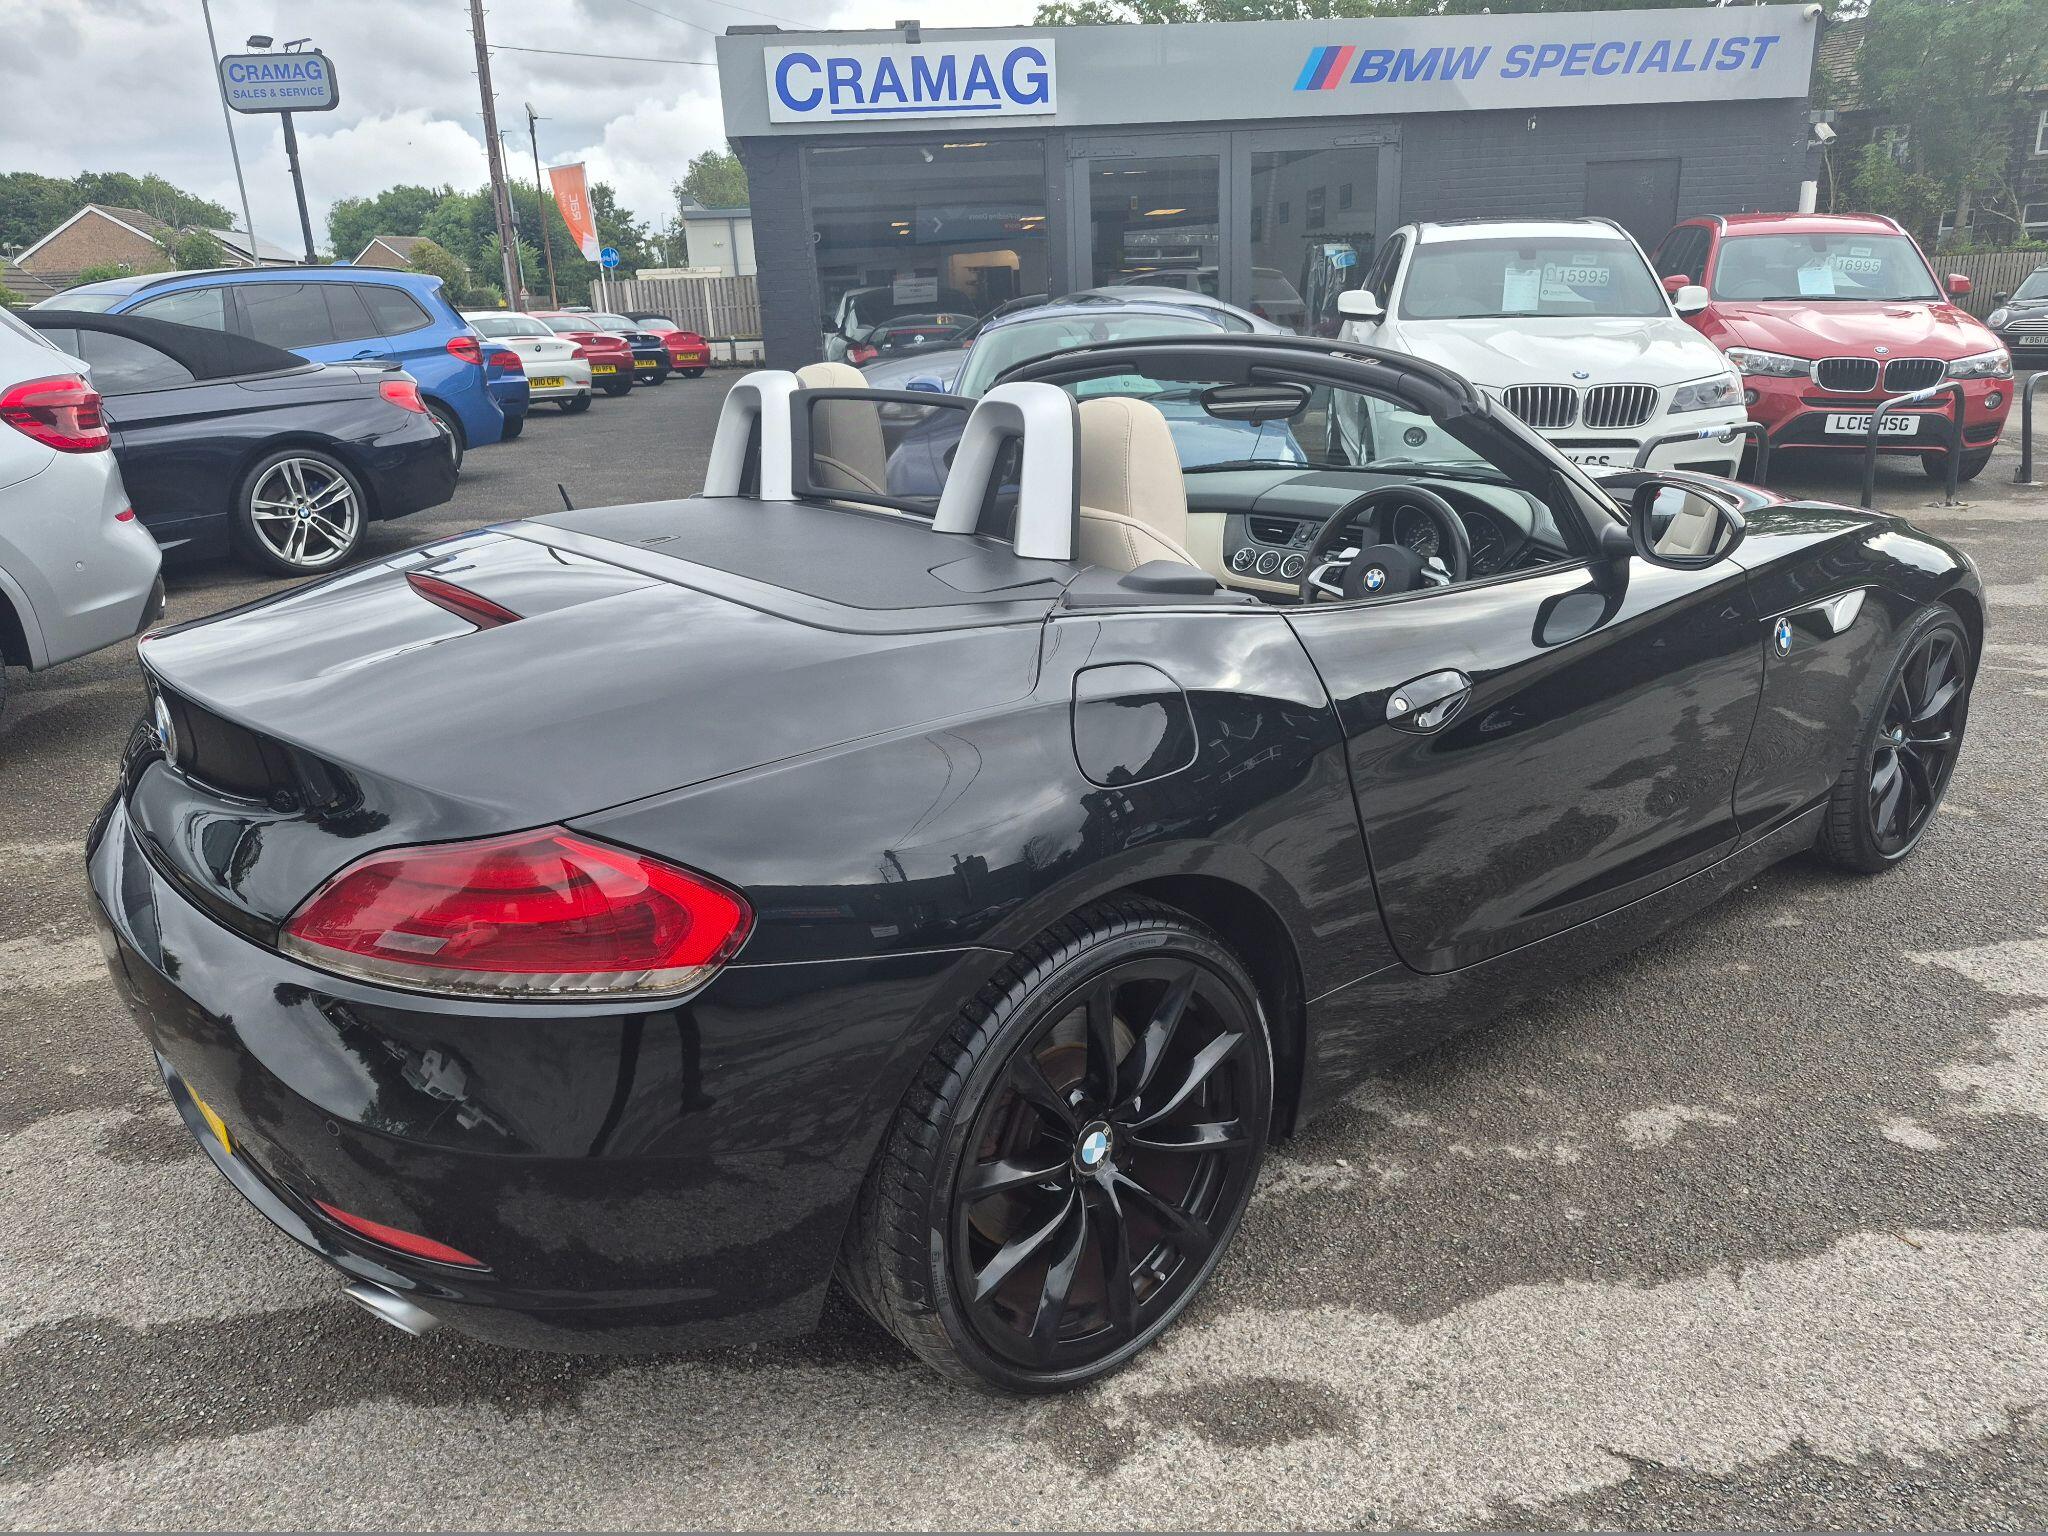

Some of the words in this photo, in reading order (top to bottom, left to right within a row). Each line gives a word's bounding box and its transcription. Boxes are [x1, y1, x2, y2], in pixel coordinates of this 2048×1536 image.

[1349, 45, 1492, 84] BMW
[1499, 35, 1780, 79] SPECIALIST
[228, 60, 322, 82] CRAMAG
[775, 46, 1049, 112] CRAMAG
[233, 88, 267, 99] SALES
[269, 88, 277, 97] &
[280, 87, 324, 97] SERVICE
[1835, 416, 1873, 430] LC15
